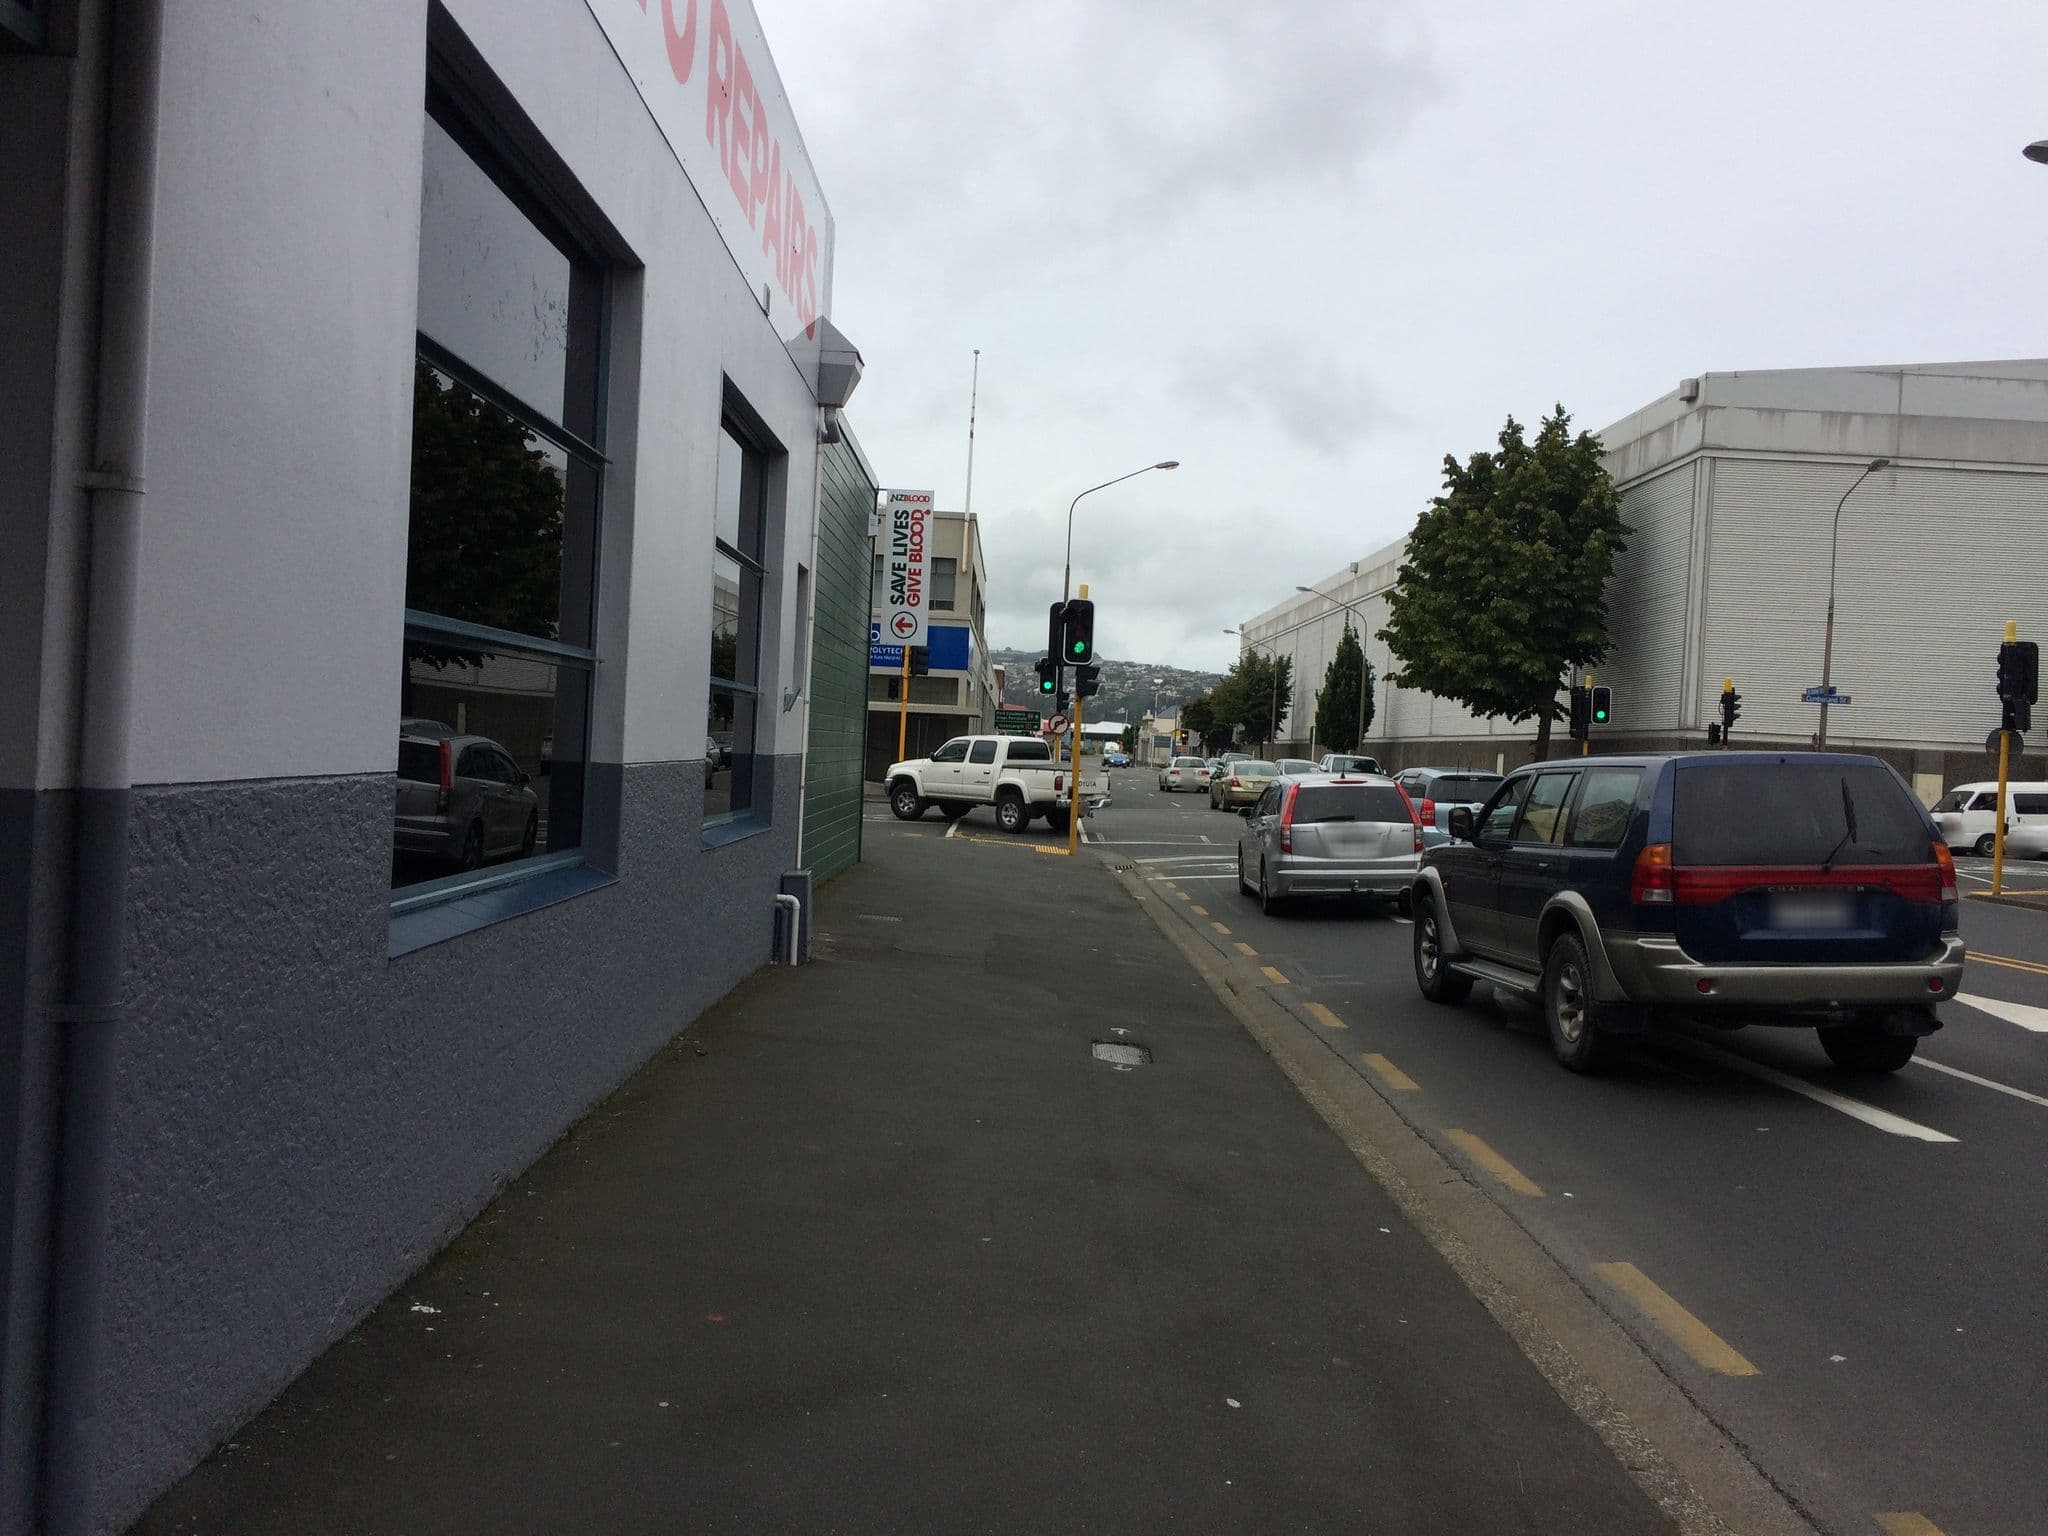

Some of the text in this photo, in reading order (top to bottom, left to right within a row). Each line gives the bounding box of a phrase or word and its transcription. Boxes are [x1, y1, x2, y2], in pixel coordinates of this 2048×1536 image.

[706, 0, 817, 341] REPAIRS
[890, 509, 910, 606] SAVE LIVES
[906, 508, 926, 607] GIVE BLOOD
